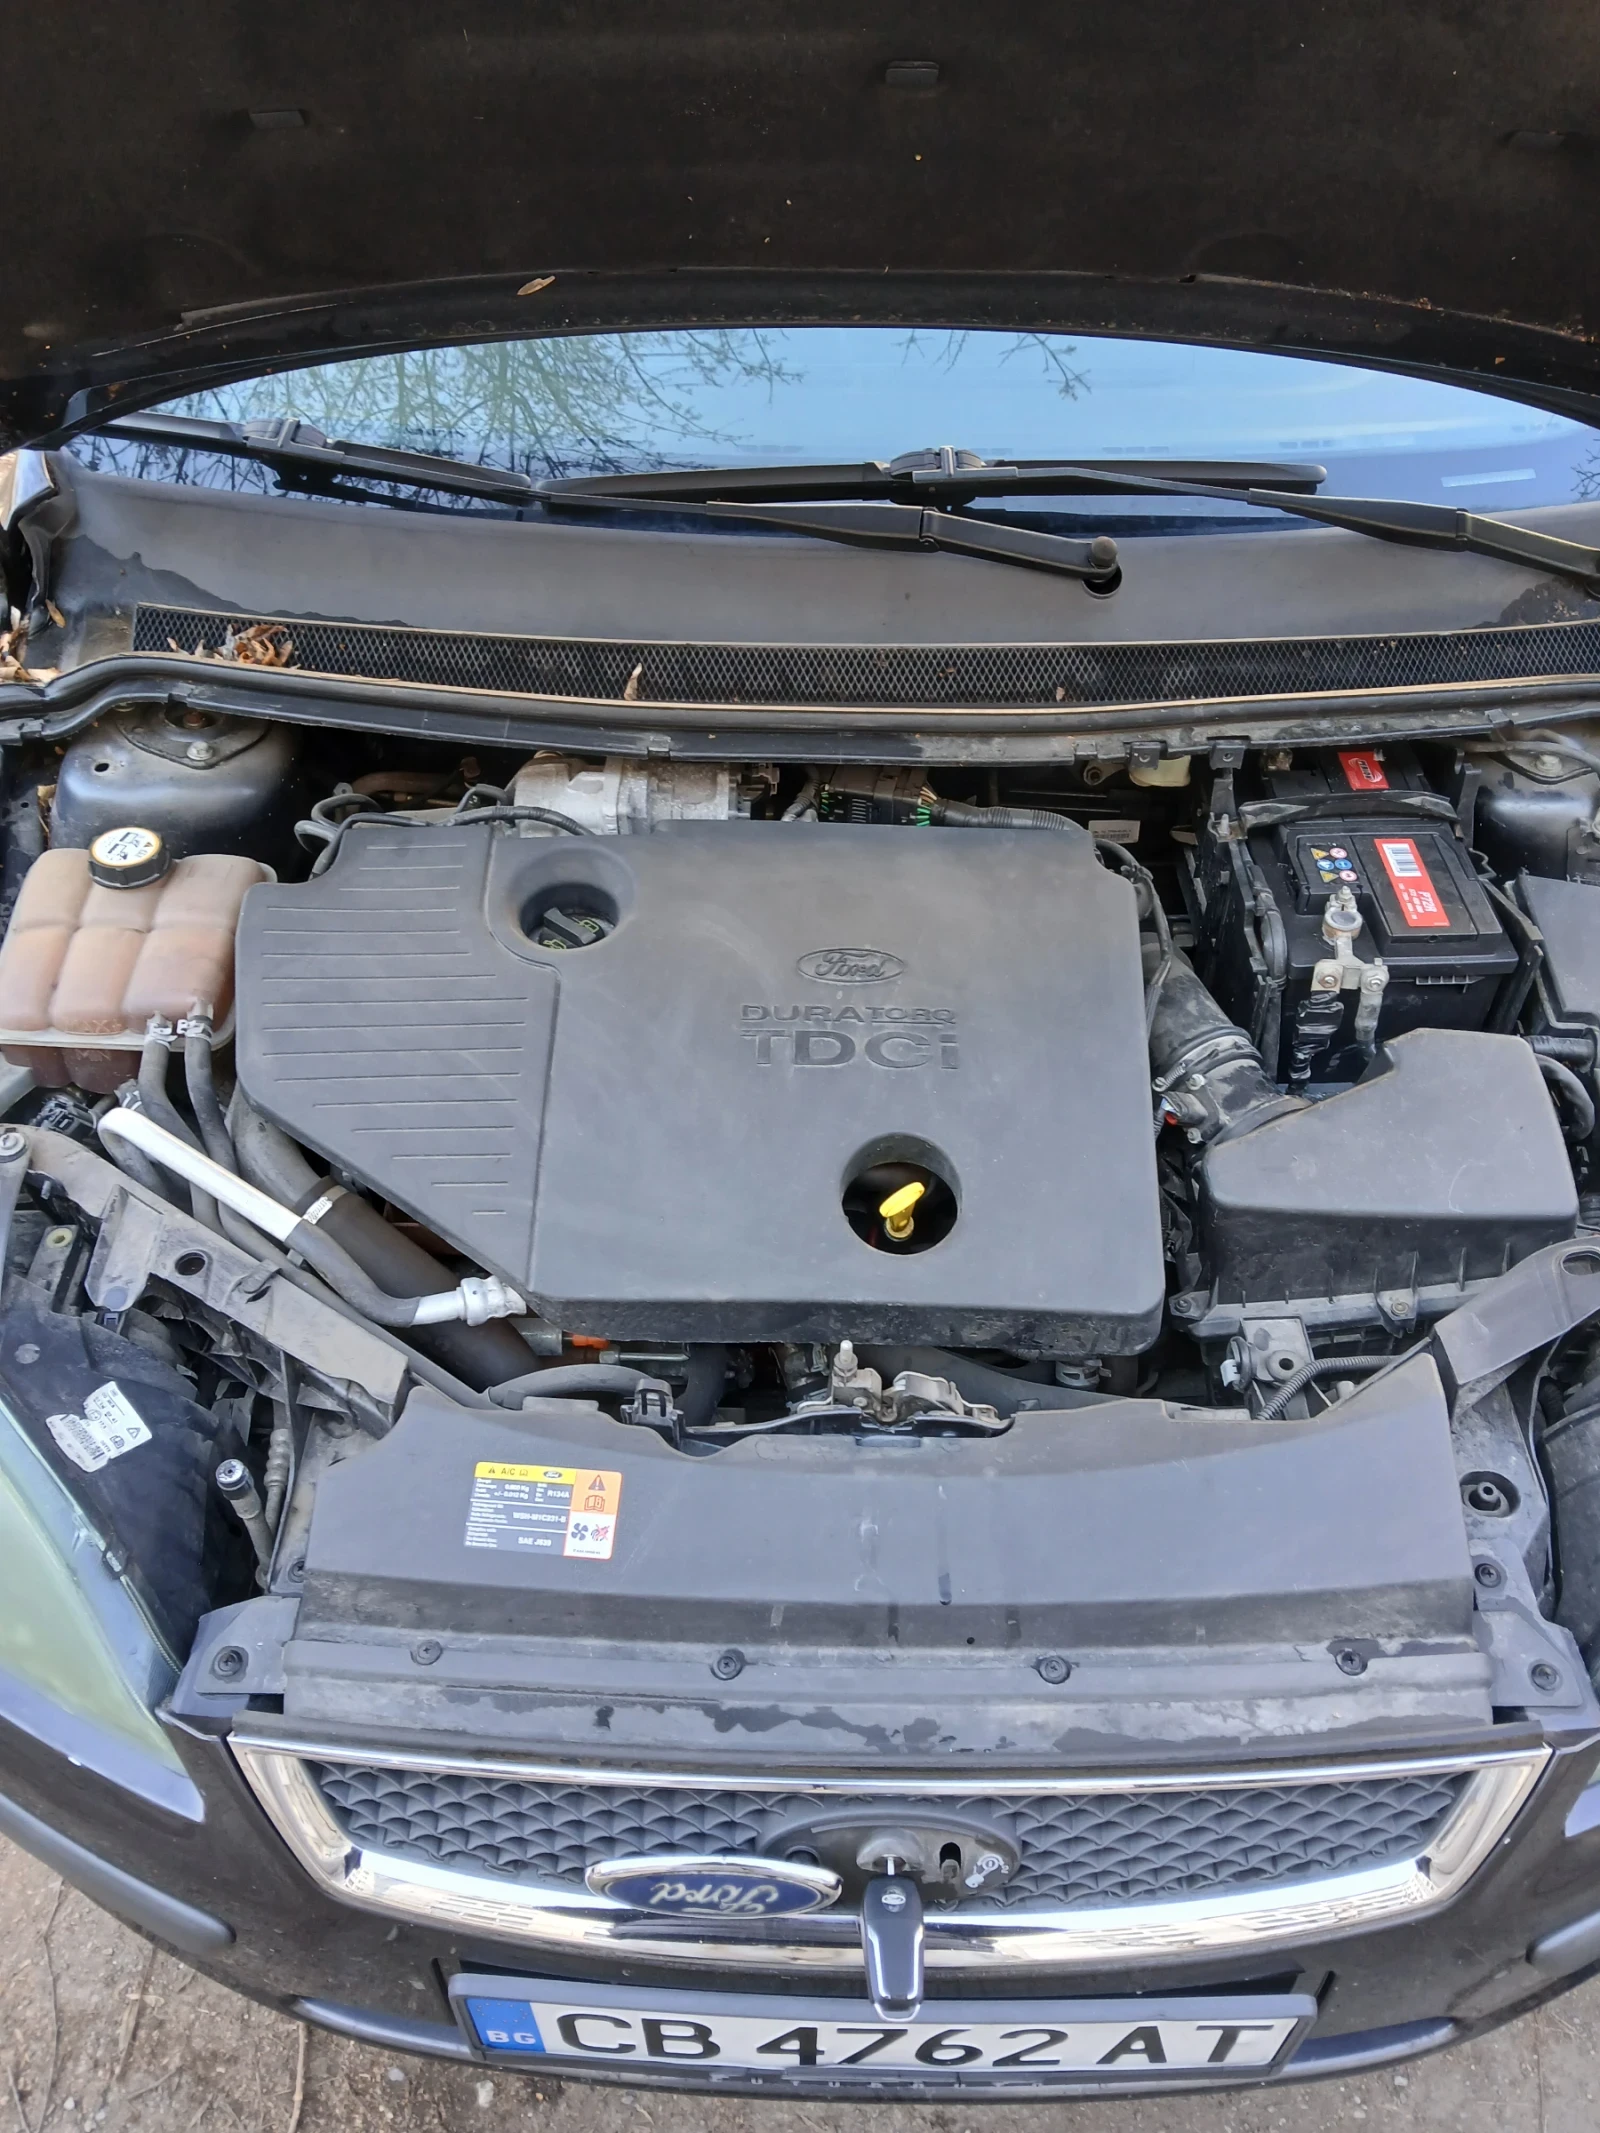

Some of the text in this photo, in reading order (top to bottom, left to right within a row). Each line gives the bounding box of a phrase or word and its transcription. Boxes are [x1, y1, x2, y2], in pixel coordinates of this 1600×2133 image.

[814, 950, 887, 978] Ford
[740, 1004, 957, 1025] DURATORQ
[740, 1029, 959, 1070] TDCi
[547, 1489, 570, 1498] R134A
[517, 1536, 534, 1545] SAE
[649, 1882, 779, 1915] Ford
[486, 2029, 537, 2045] BG
[556, 2013, 1275, 2067] CB 4762 AT
